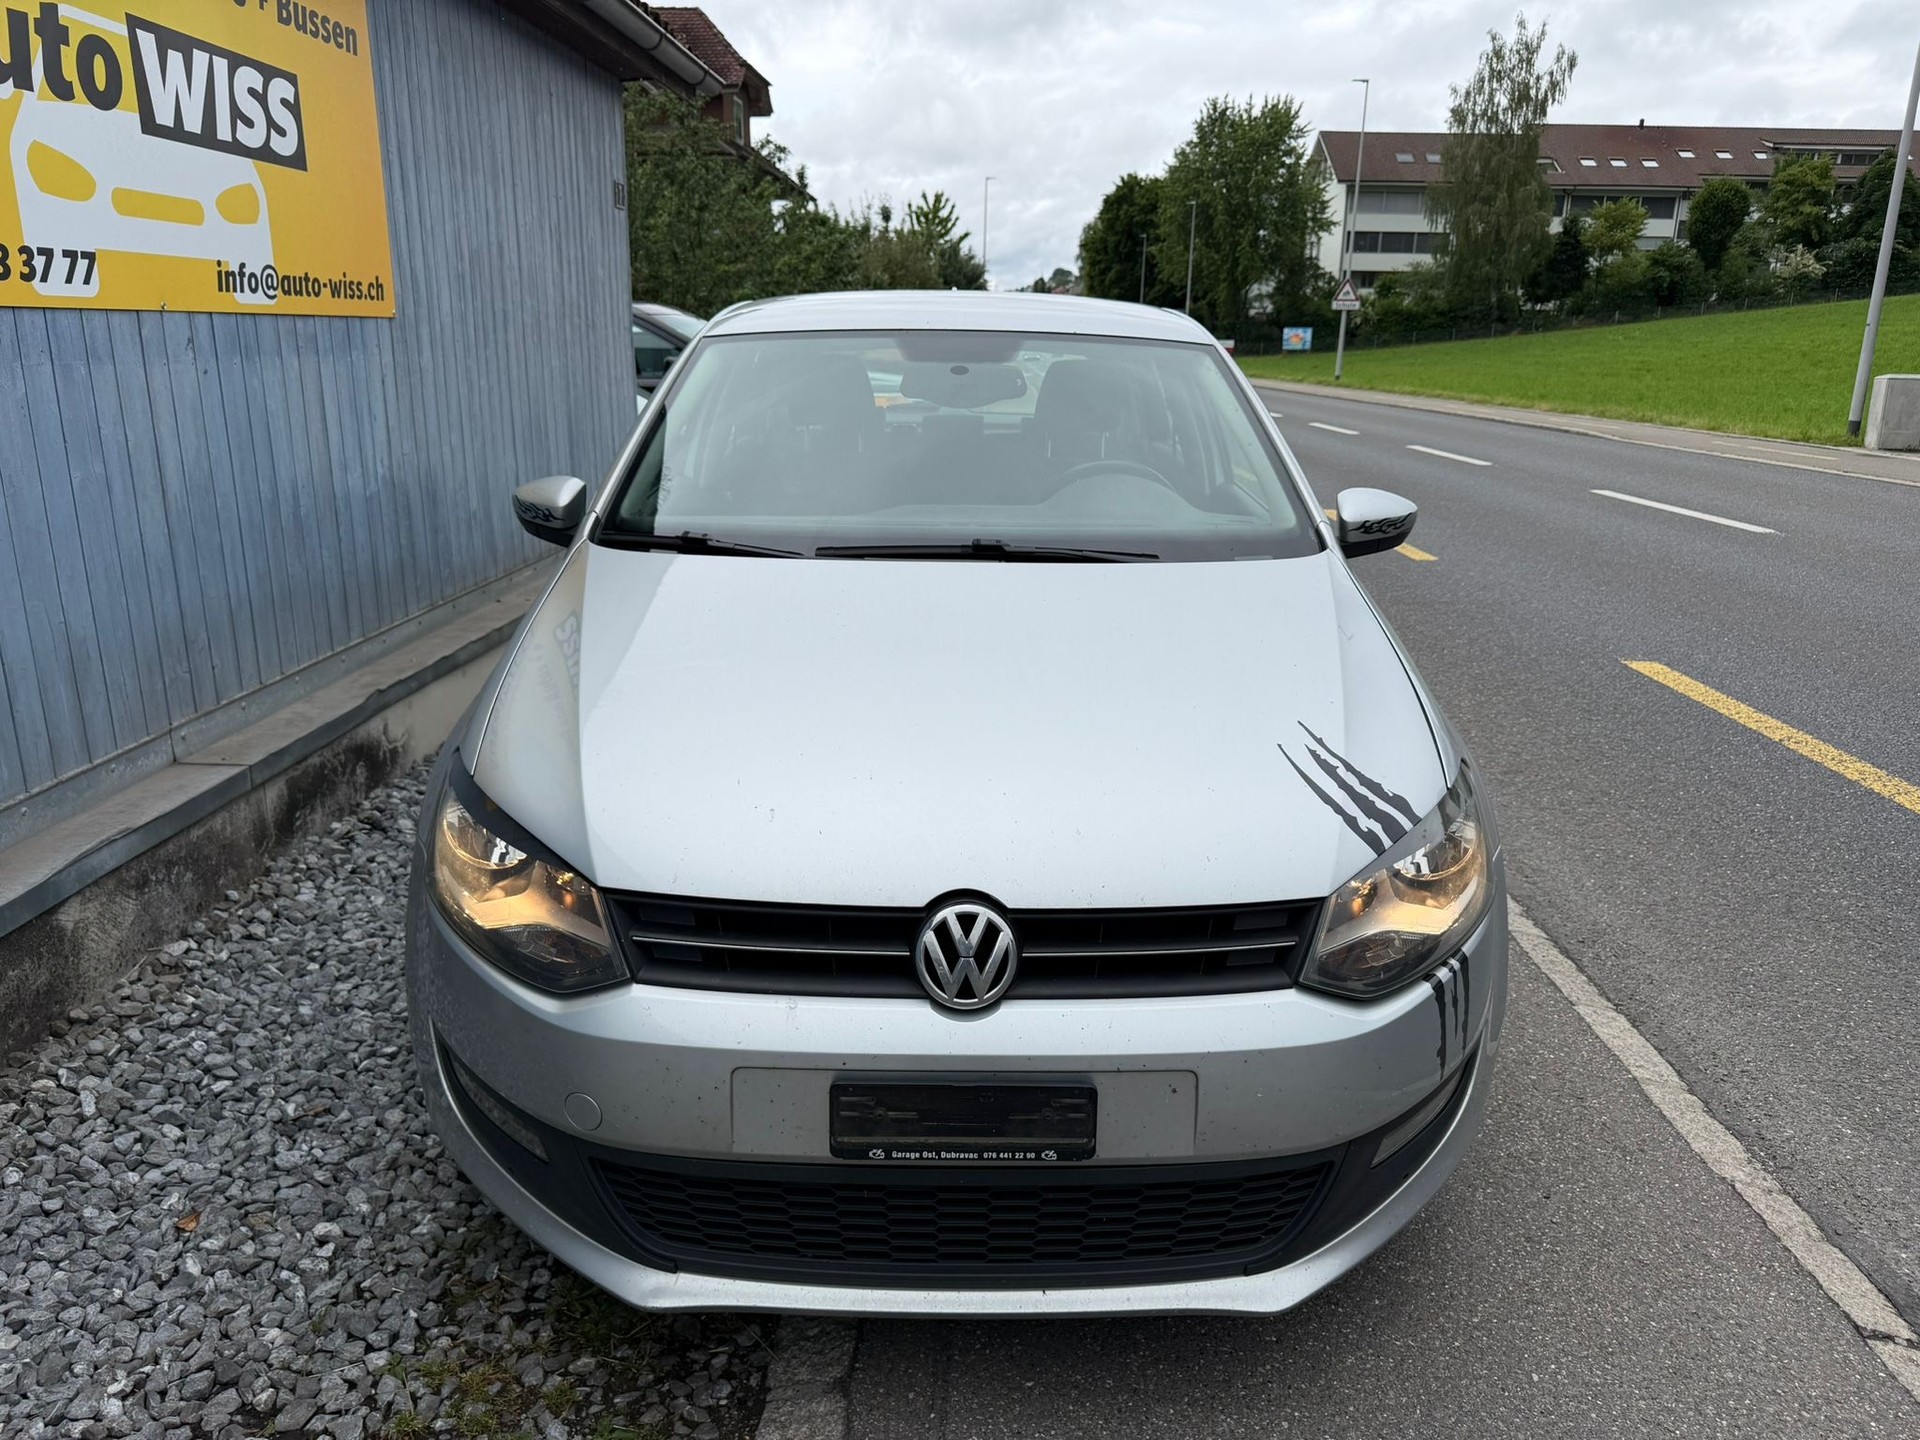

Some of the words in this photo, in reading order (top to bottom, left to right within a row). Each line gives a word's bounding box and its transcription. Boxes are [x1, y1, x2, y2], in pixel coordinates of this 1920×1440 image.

[277, 0, 357, 56] Bussen
[136, 28, 299, 156] WISS
[18, 245, 54, 283] 37
[62, 249, 96, 285] 77
[216, 259, 384, 301] info@auto-wiss.ch
[892, 1151, 920, 1159] Garage
[922, 1151, 938, 1159] Ost,
[941, 1151, 979, 1159] Dubravac
